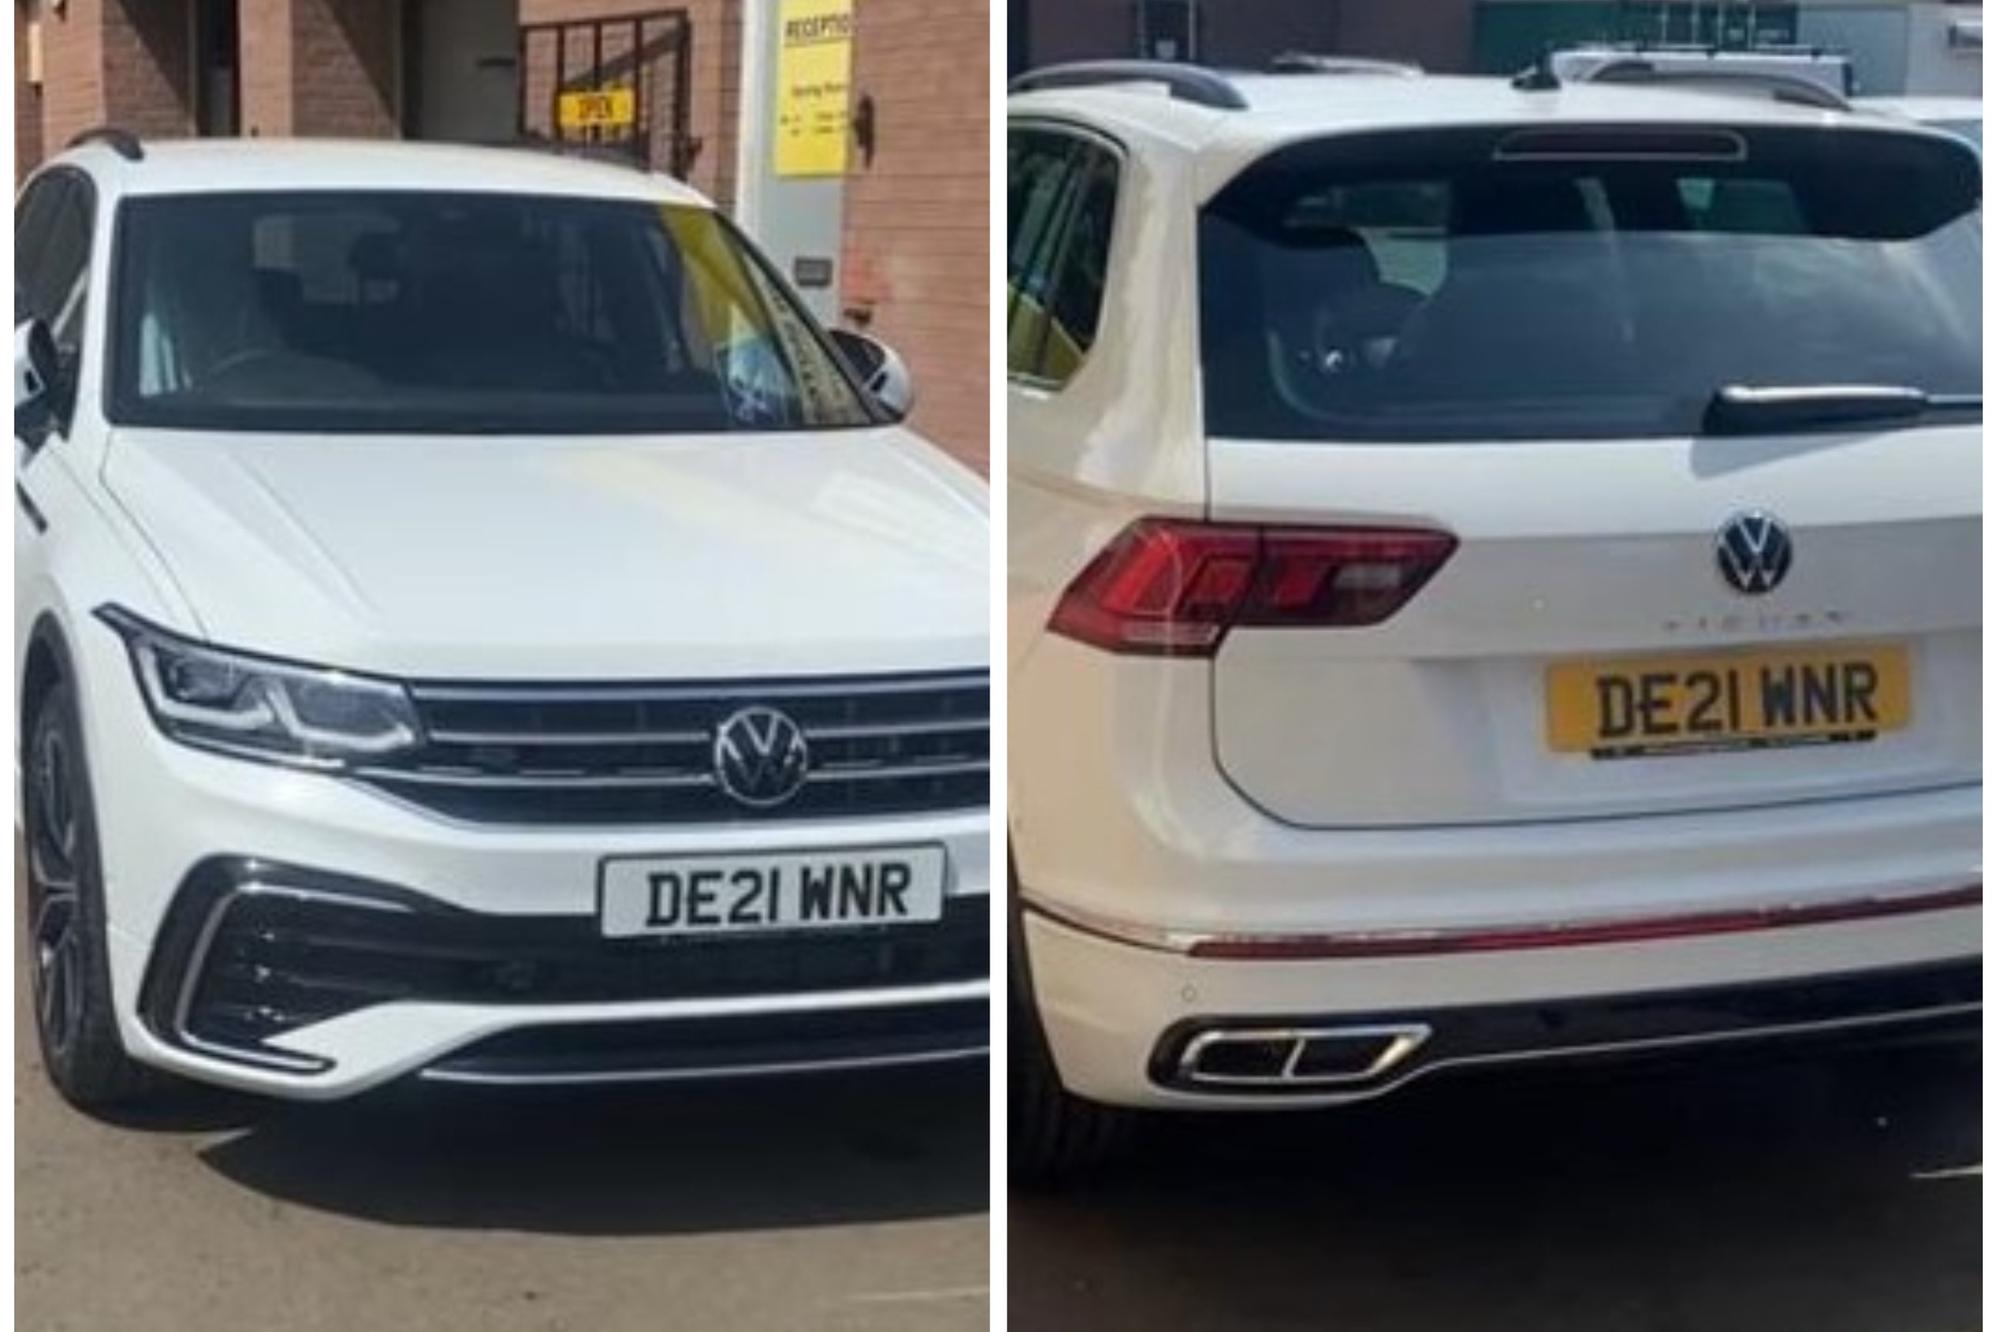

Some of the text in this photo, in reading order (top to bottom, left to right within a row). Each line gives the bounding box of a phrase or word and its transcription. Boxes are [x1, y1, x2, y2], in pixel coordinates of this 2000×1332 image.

[1596, 661, 1878, 739] DE21 WNR
[645, 862, 911, 927] DE21 WNR
